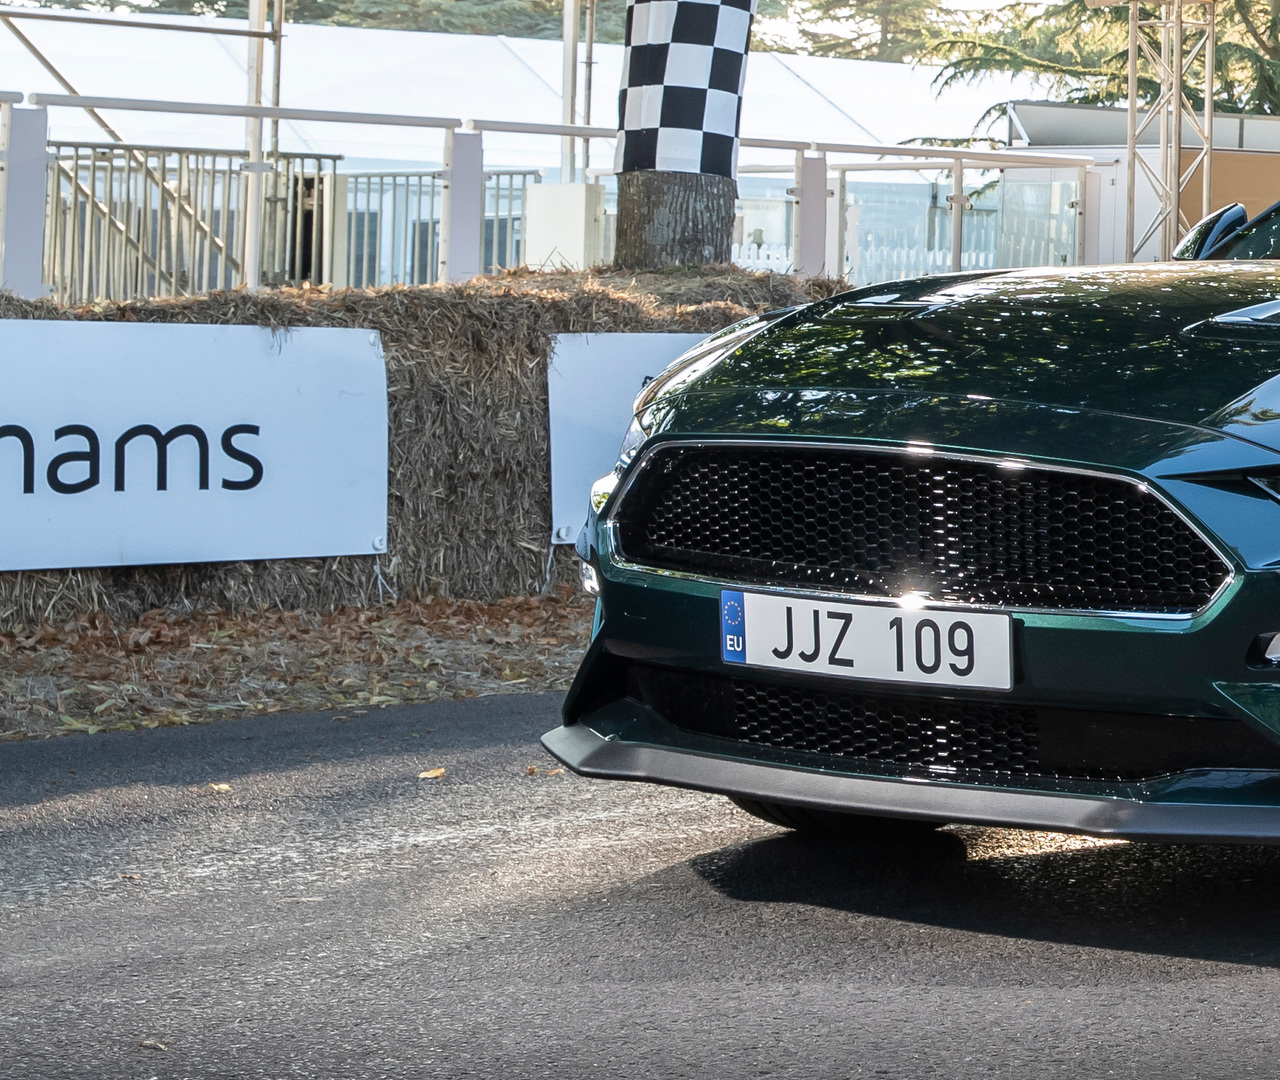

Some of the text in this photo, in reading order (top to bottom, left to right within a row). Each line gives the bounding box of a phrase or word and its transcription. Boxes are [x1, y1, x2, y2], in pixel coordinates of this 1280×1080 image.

[726, 635, 743, 653] EU
[771, 606, 975, 677] JJZ 109
